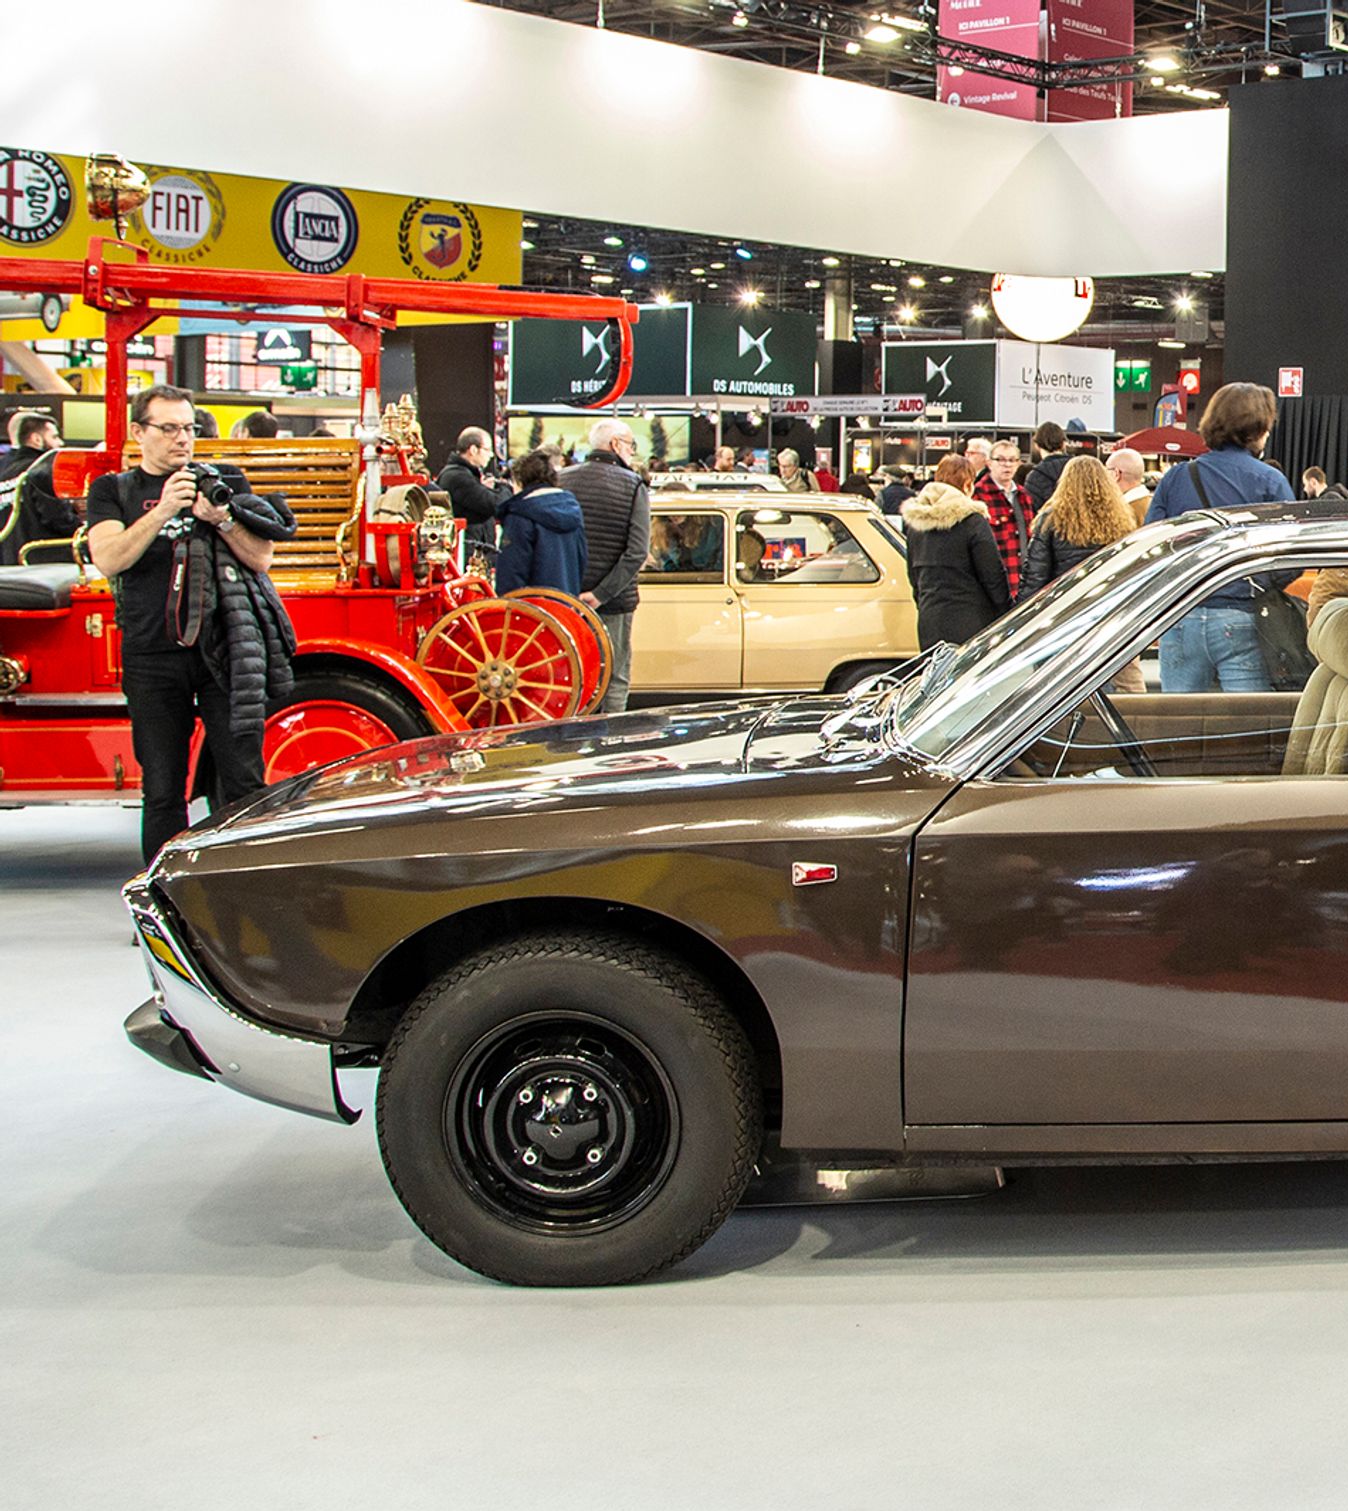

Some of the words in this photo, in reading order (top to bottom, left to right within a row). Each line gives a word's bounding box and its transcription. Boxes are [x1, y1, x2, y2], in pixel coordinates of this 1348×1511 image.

[969, 18, 1004, 28] PAVILLON
[151, 191, 204, 233] FIAT
[0, 215, 63, 241] ASSICHE
[299, 212, 338, 239] LANCIA
[287, 253, 344, 273] CLASSICHE
[571, 380, 582, 393] DS
[714, 379, 727, 392] DS
[729, 380, 794, 396] AUTOMOBILES
[1082, 394, 1092, 405] DS
